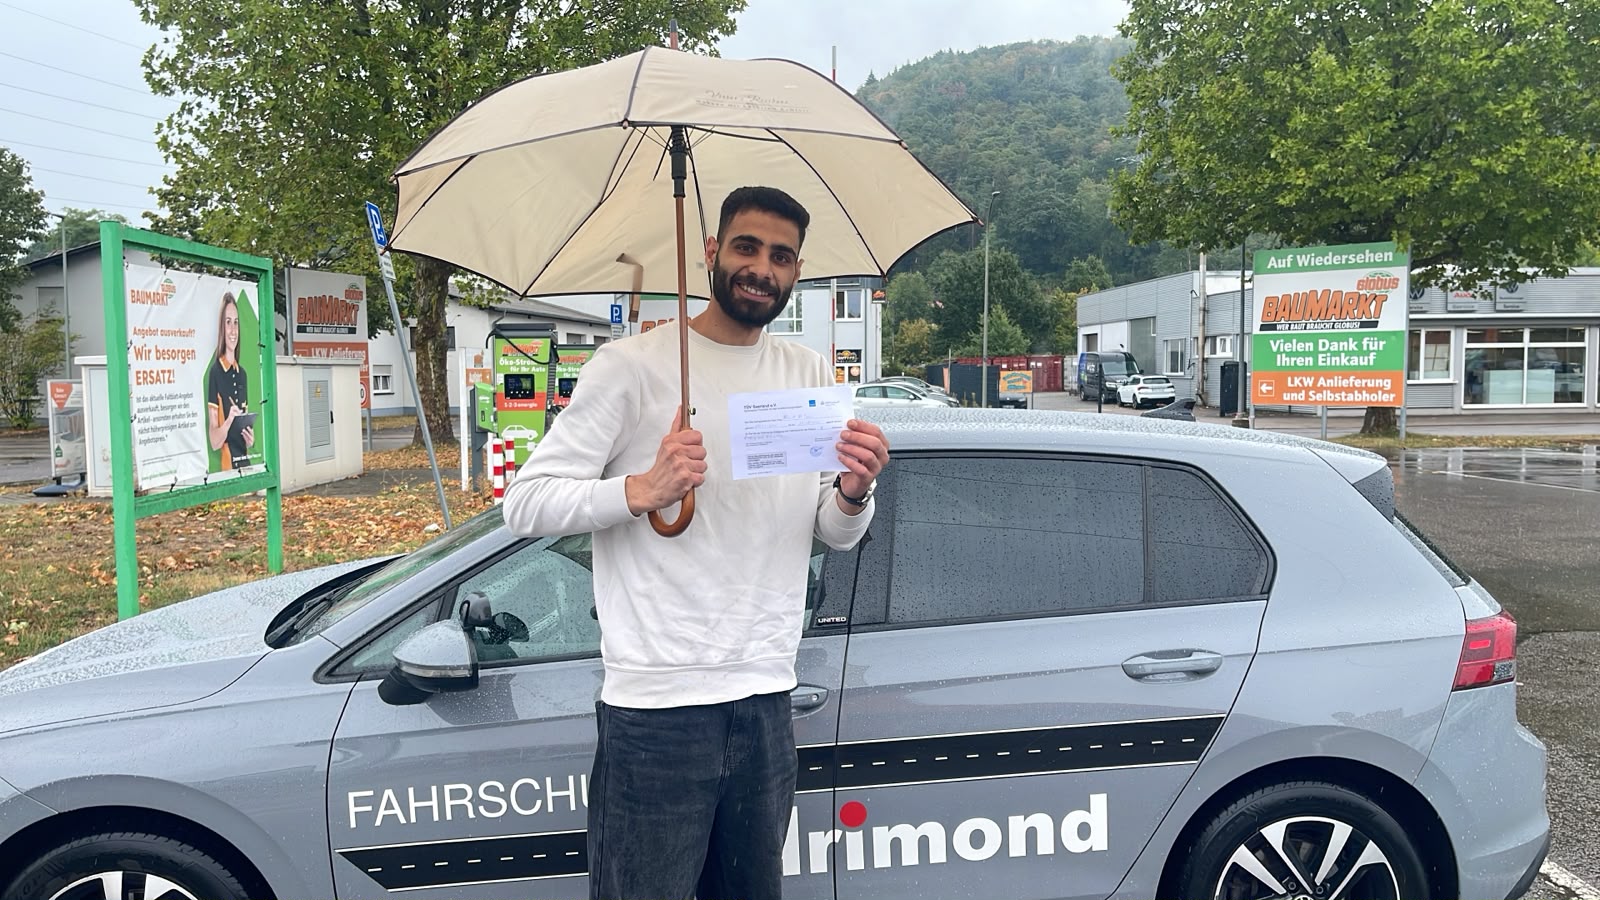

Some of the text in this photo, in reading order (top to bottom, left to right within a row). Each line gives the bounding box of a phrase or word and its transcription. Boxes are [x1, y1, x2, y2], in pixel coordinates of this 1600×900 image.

[1267, 249, 1393, 269] Auf Wiedersehen
[130, 289, 169, 306] BAUMARKT
[297, 294, 359, 326] BAUMARKT
[612, 306, 620, 321] P
[1261, 289, 1388, 323] BAUMARKT
[133, 326, 196, 339] Angebot ausverkauft?
[1276, 321, 1360, 331] WER BAUT BRAUCHT GLOBUS!
[1270, 337, 1386, 352] Vielen Dank für
[134, 344, 196, 364] Wir besorgen
[311, 348, 328, 358] LKW
[1276, 352, 1376, 366] Ihren Einkauf
[136, 369, 175, 386] ERSATZ!
[1287, 376, 1392, 390] LKW Anlieferung
[1283, 390, 1396, 402] und Selbstabholer
